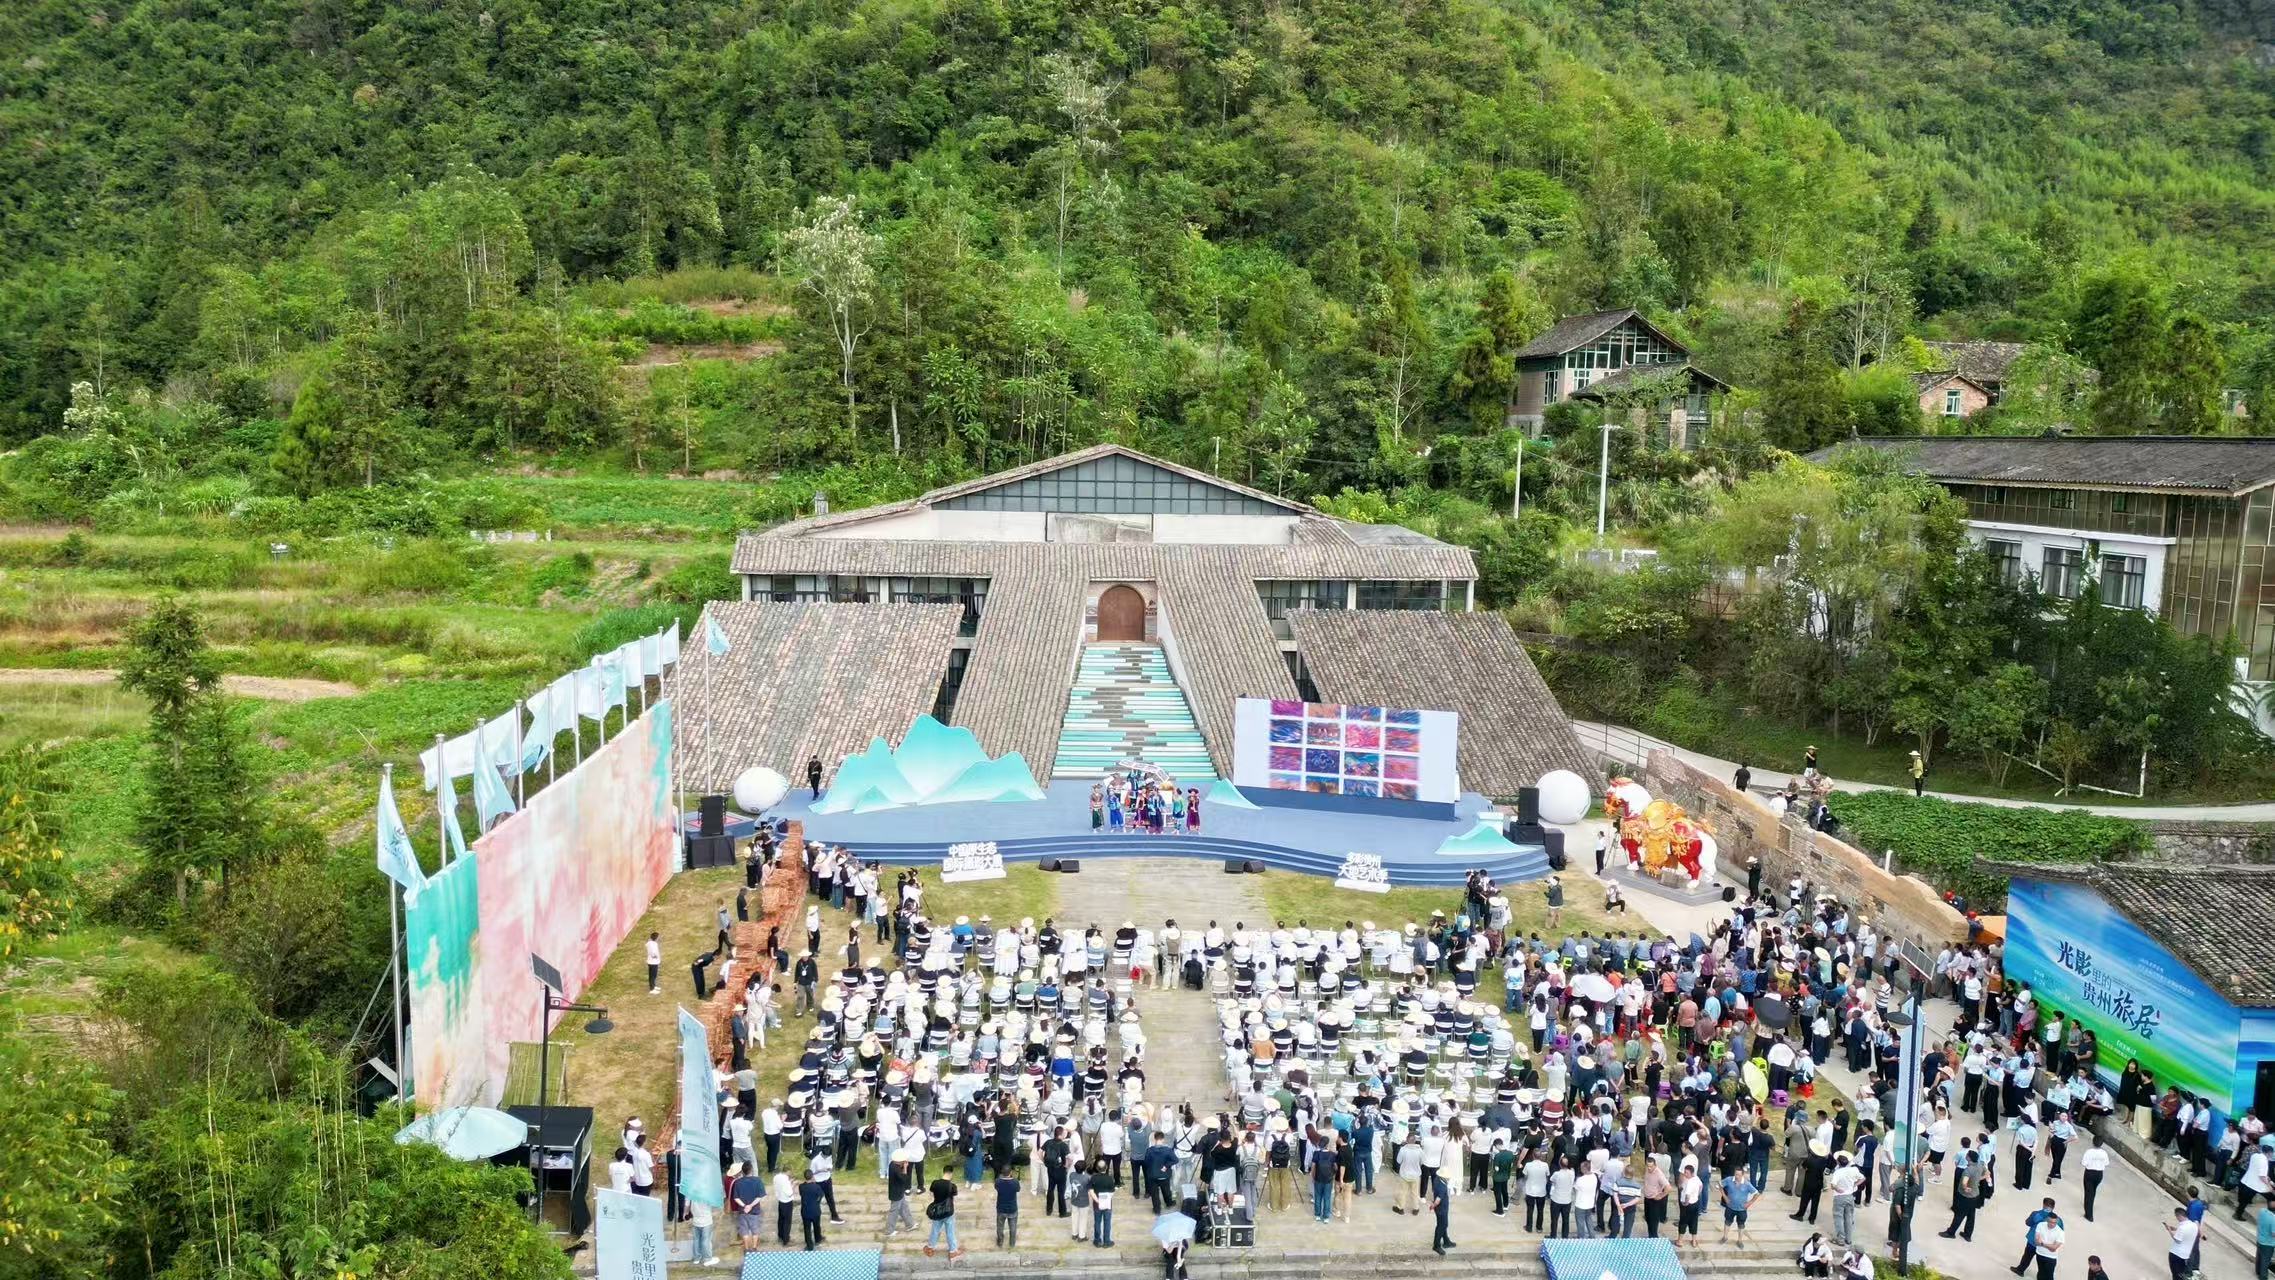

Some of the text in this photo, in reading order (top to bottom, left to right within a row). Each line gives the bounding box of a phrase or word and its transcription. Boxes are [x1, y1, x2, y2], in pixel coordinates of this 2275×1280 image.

[2057, 940, 2112, 991] 光影里的
[2083, 982, 2160, 1040] 贵州旅居
[641, 1232, 656, 1280] 光影里
